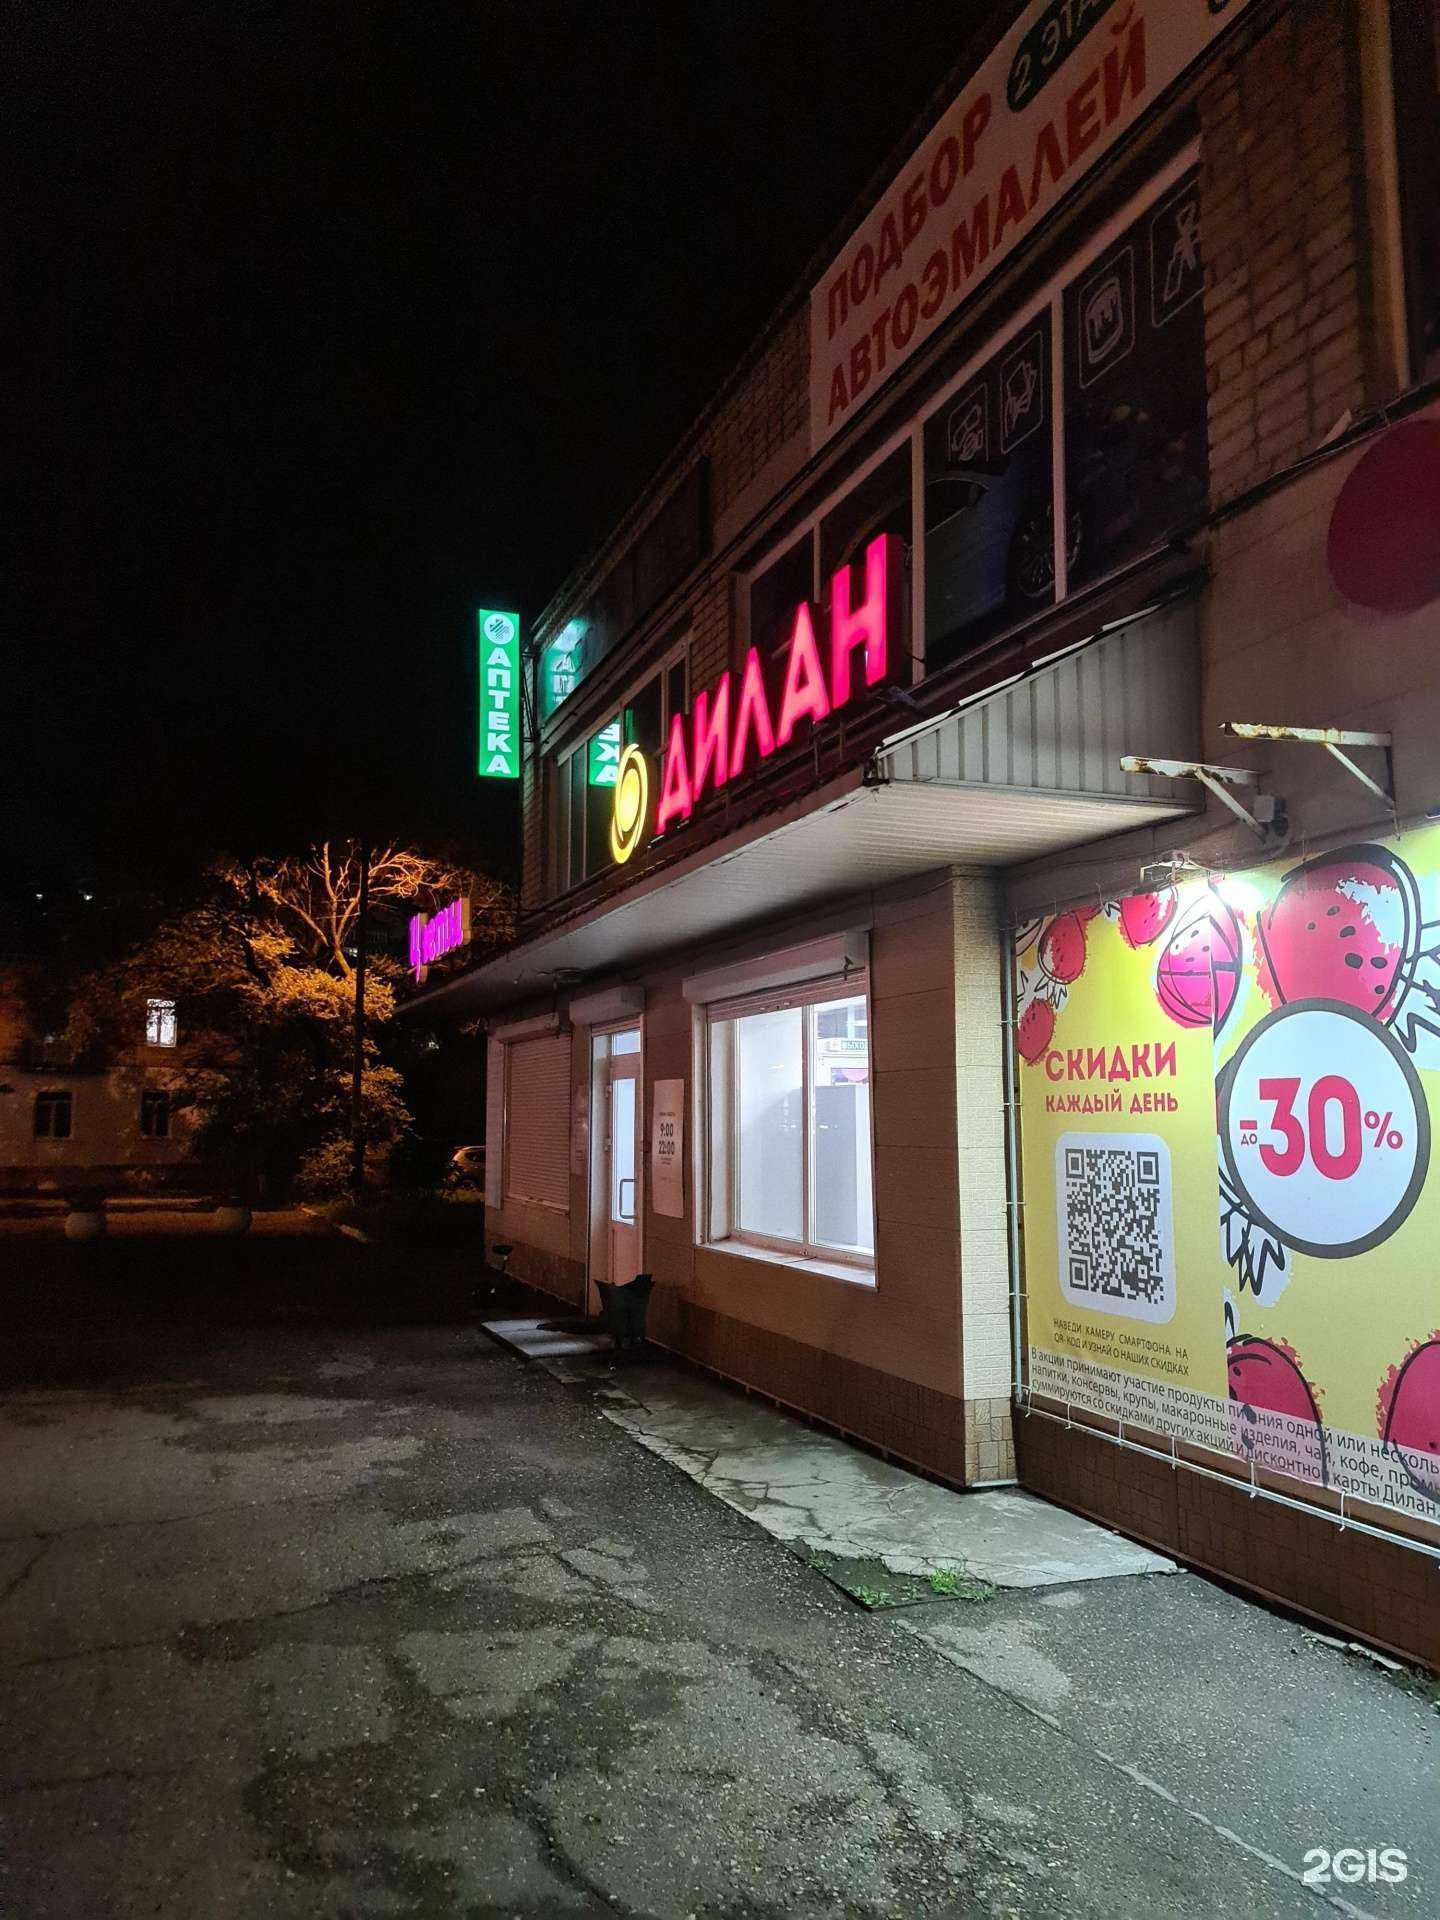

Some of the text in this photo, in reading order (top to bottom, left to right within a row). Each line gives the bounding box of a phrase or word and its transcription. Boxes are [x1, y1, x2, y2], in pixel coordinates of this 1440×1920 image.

[1014, 53, 1033, 104] 2
[827, 1, 1147, 426] АВТОЭМАЛЕЙ
[827, 93, 992, 340] ПОДБОР
[487, 647, 513, 774] АПТЕКА
[656, 532, 887, 835] ДИЛАН
[1045, 1041, 1177, 1082] СКИДКИ
[1045, 1088, 1179, 1114] КАЖДЫЙ ДЕНЬ
[1053, 1318, 1189, 1360] НАВЕДИ КАМЕРУ СМАРТФОНА НА
[1081, 1340, 1088, 1349] И
[1089, 1341, 1112, 1357] УЗНАЙ
[1113, 1347, 1120, 1358] О
[1120, 1350, 1150, 1367] НАШИХ
[1150, 1357, 1189, 1376] СКИДКАХ
[1031, 1347, 1037, 1359] В
[1038, 1351, 1065, 1366] акции
[1066, 1359, 1122, 1383] принимают
[1123, 1374, 1166, 1397] участие
[1167, 1387, 1225, 1414] продукты
[1228, 1404, 1283, 1430] пиния
[1286, 1421, 1333, 1445] одной
[1337, 1434, 1366, 1452] или
[1032, 1364, 1070, 1384] напитки,
[1071, 1376, 1121, 1400] консервы,
[1123, 1391, 1159, 1412] крупы,
[1161, 1403, 1237, 1434] макаронные
[1241, 1427, 1300, 1455] изделия,
[1340, 1455, 1384, 1481] кофе,
[1032, 1379, 1092, 1404] суммируются
[1092, 1397, 1104, 1409] со
[1105, 1402, 1155, 1426] скидками
[1156, 1419, 1197, 1438] других
[1196, 1429, 1234, 1452] акций
[1236, 1443, 1244, 1456] и
[1333, 1473, 1380, 1498] карты
